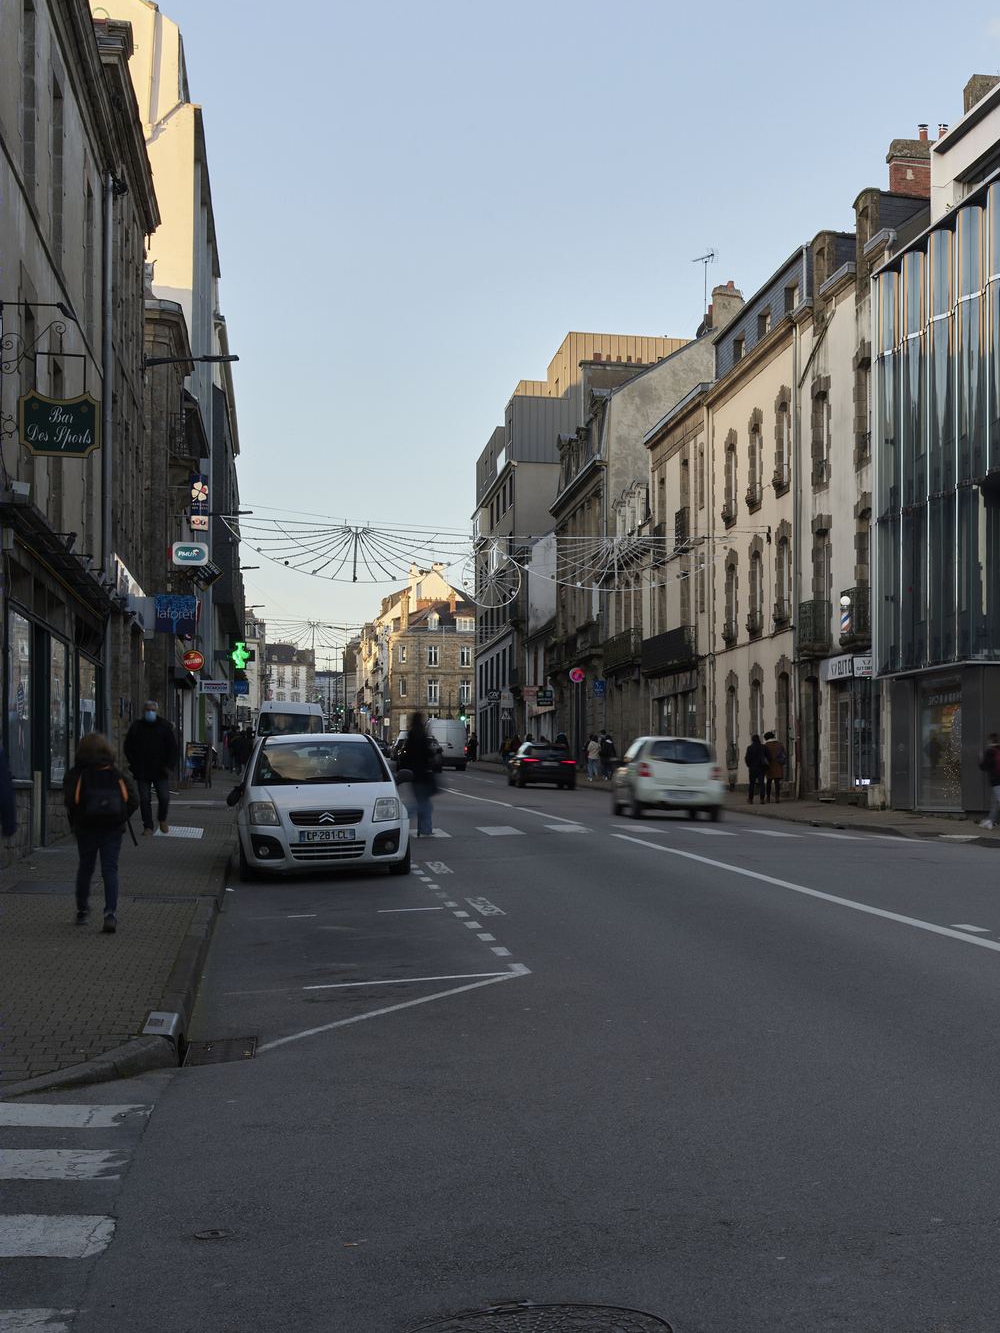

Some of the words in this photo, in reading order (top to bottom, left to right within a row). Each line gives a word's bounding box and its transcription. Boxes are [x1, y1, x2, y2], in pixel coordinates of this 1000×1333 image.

[48, 405, 74, 424] Bar
[27, 423, 49, 442] Des
[53, 425, 92, 449] Sports
[157, 607, 194, 620] laforêt
[306, 830, 349, 841] CP-281-CL
